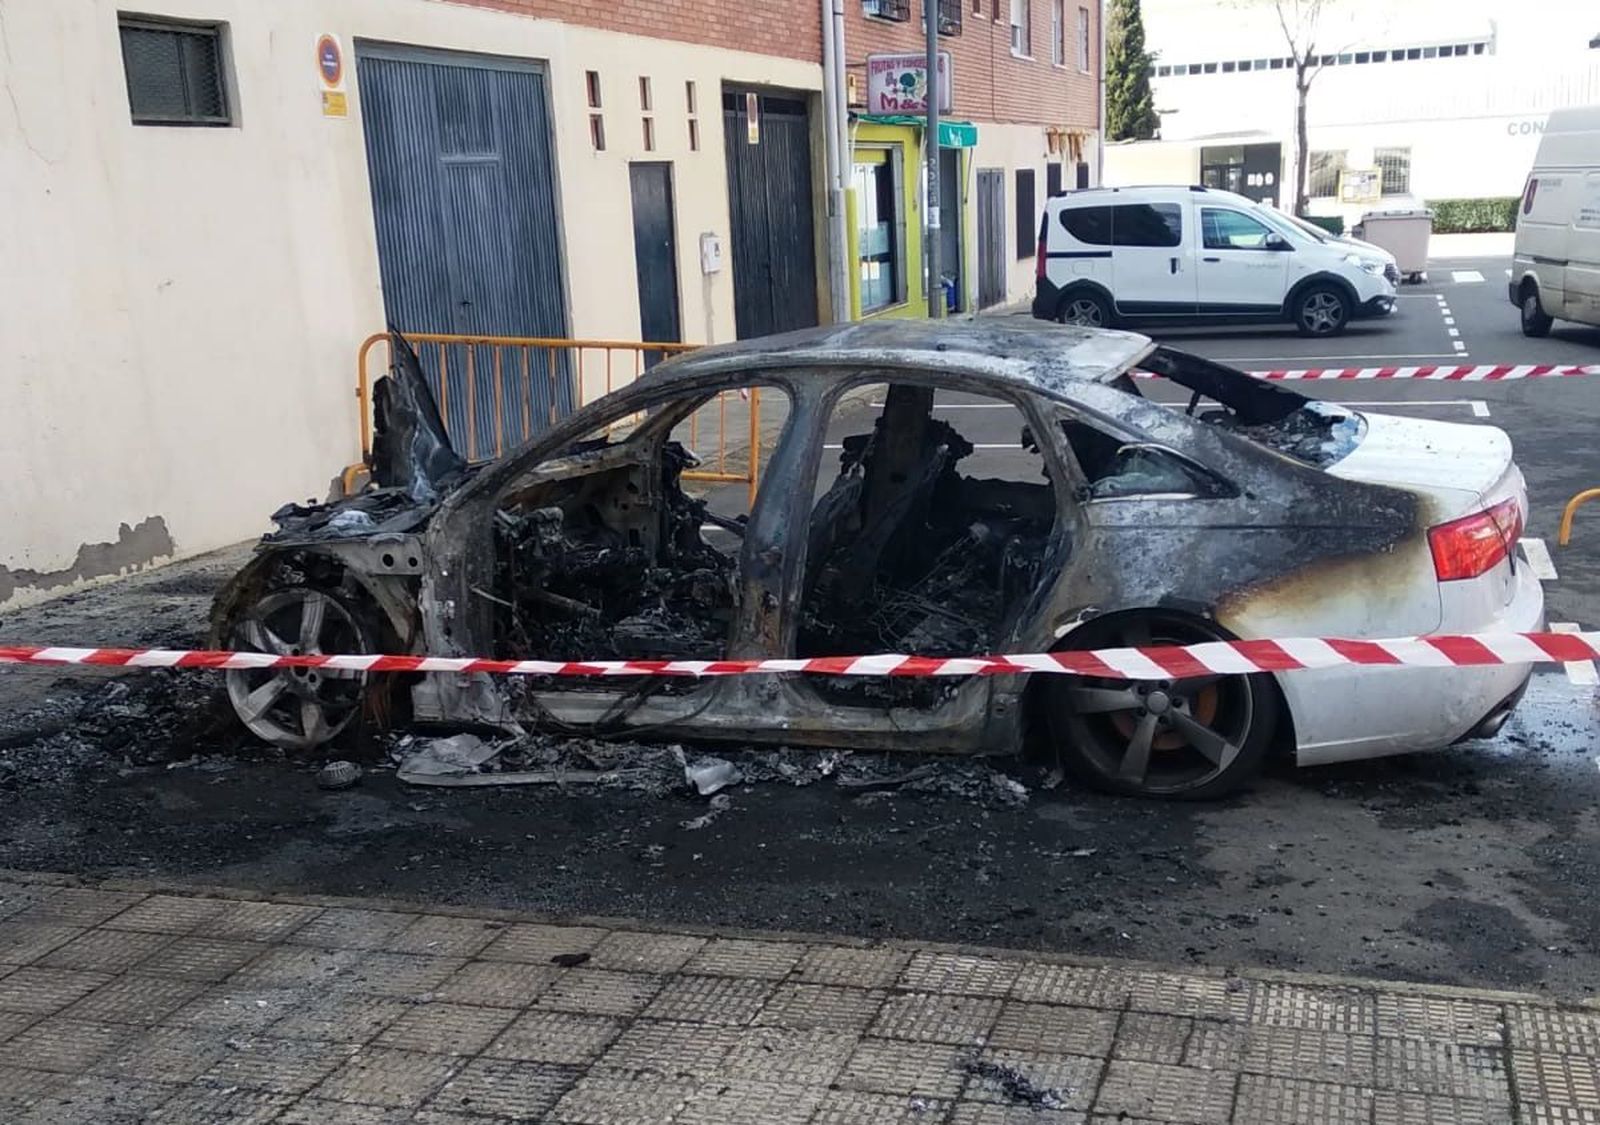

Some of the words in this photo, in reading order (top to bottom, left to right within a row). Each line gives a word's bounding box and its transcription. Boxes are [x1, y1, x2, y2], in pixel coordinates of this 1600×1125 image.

[871, 59, 895, 75] FRUTAS
[880, 91, 898, 110] M
[1507, 120, 1549, 136] CON
